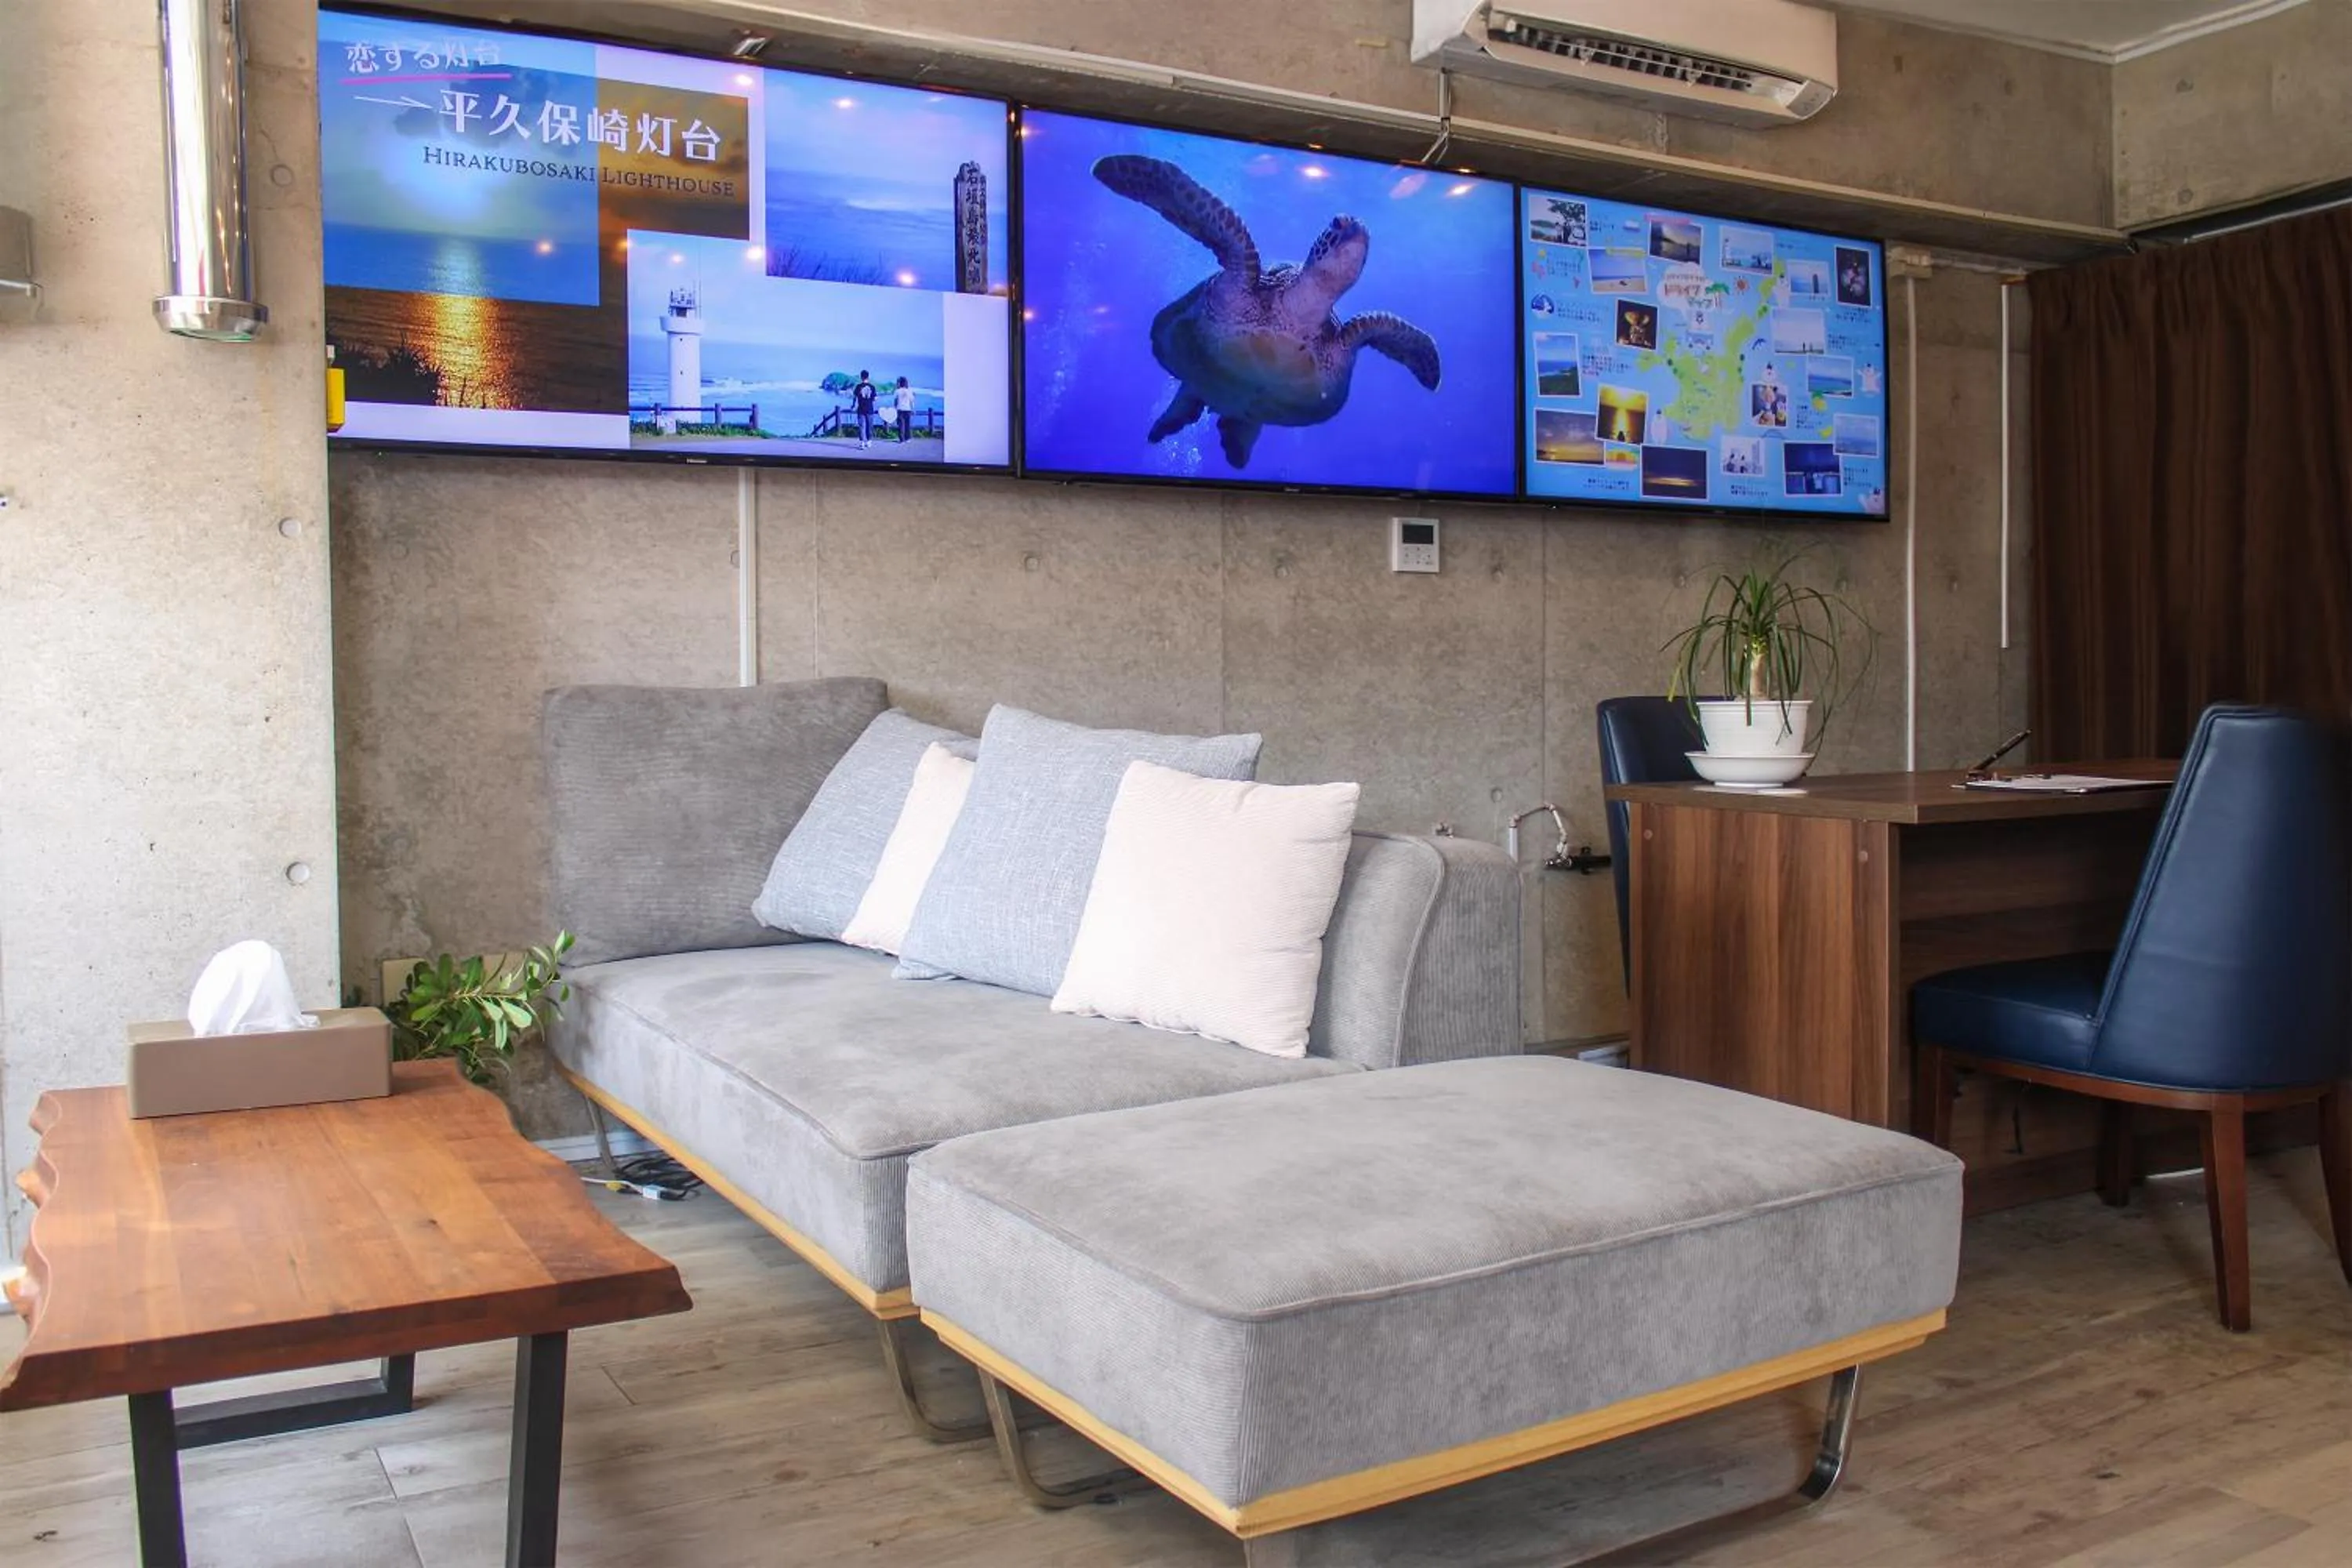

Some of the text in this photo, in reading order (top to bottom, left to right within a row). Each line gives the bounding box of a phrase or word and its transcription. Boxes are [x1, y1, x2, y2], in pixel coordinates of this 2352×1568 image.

[344, 41, 500, 74] 恋する灯台
[439, 89, 721, 162] 平久保崎灯台
[423, 146, 735, 198] HIRAKUBOSAKI LIGHTHOUSE
